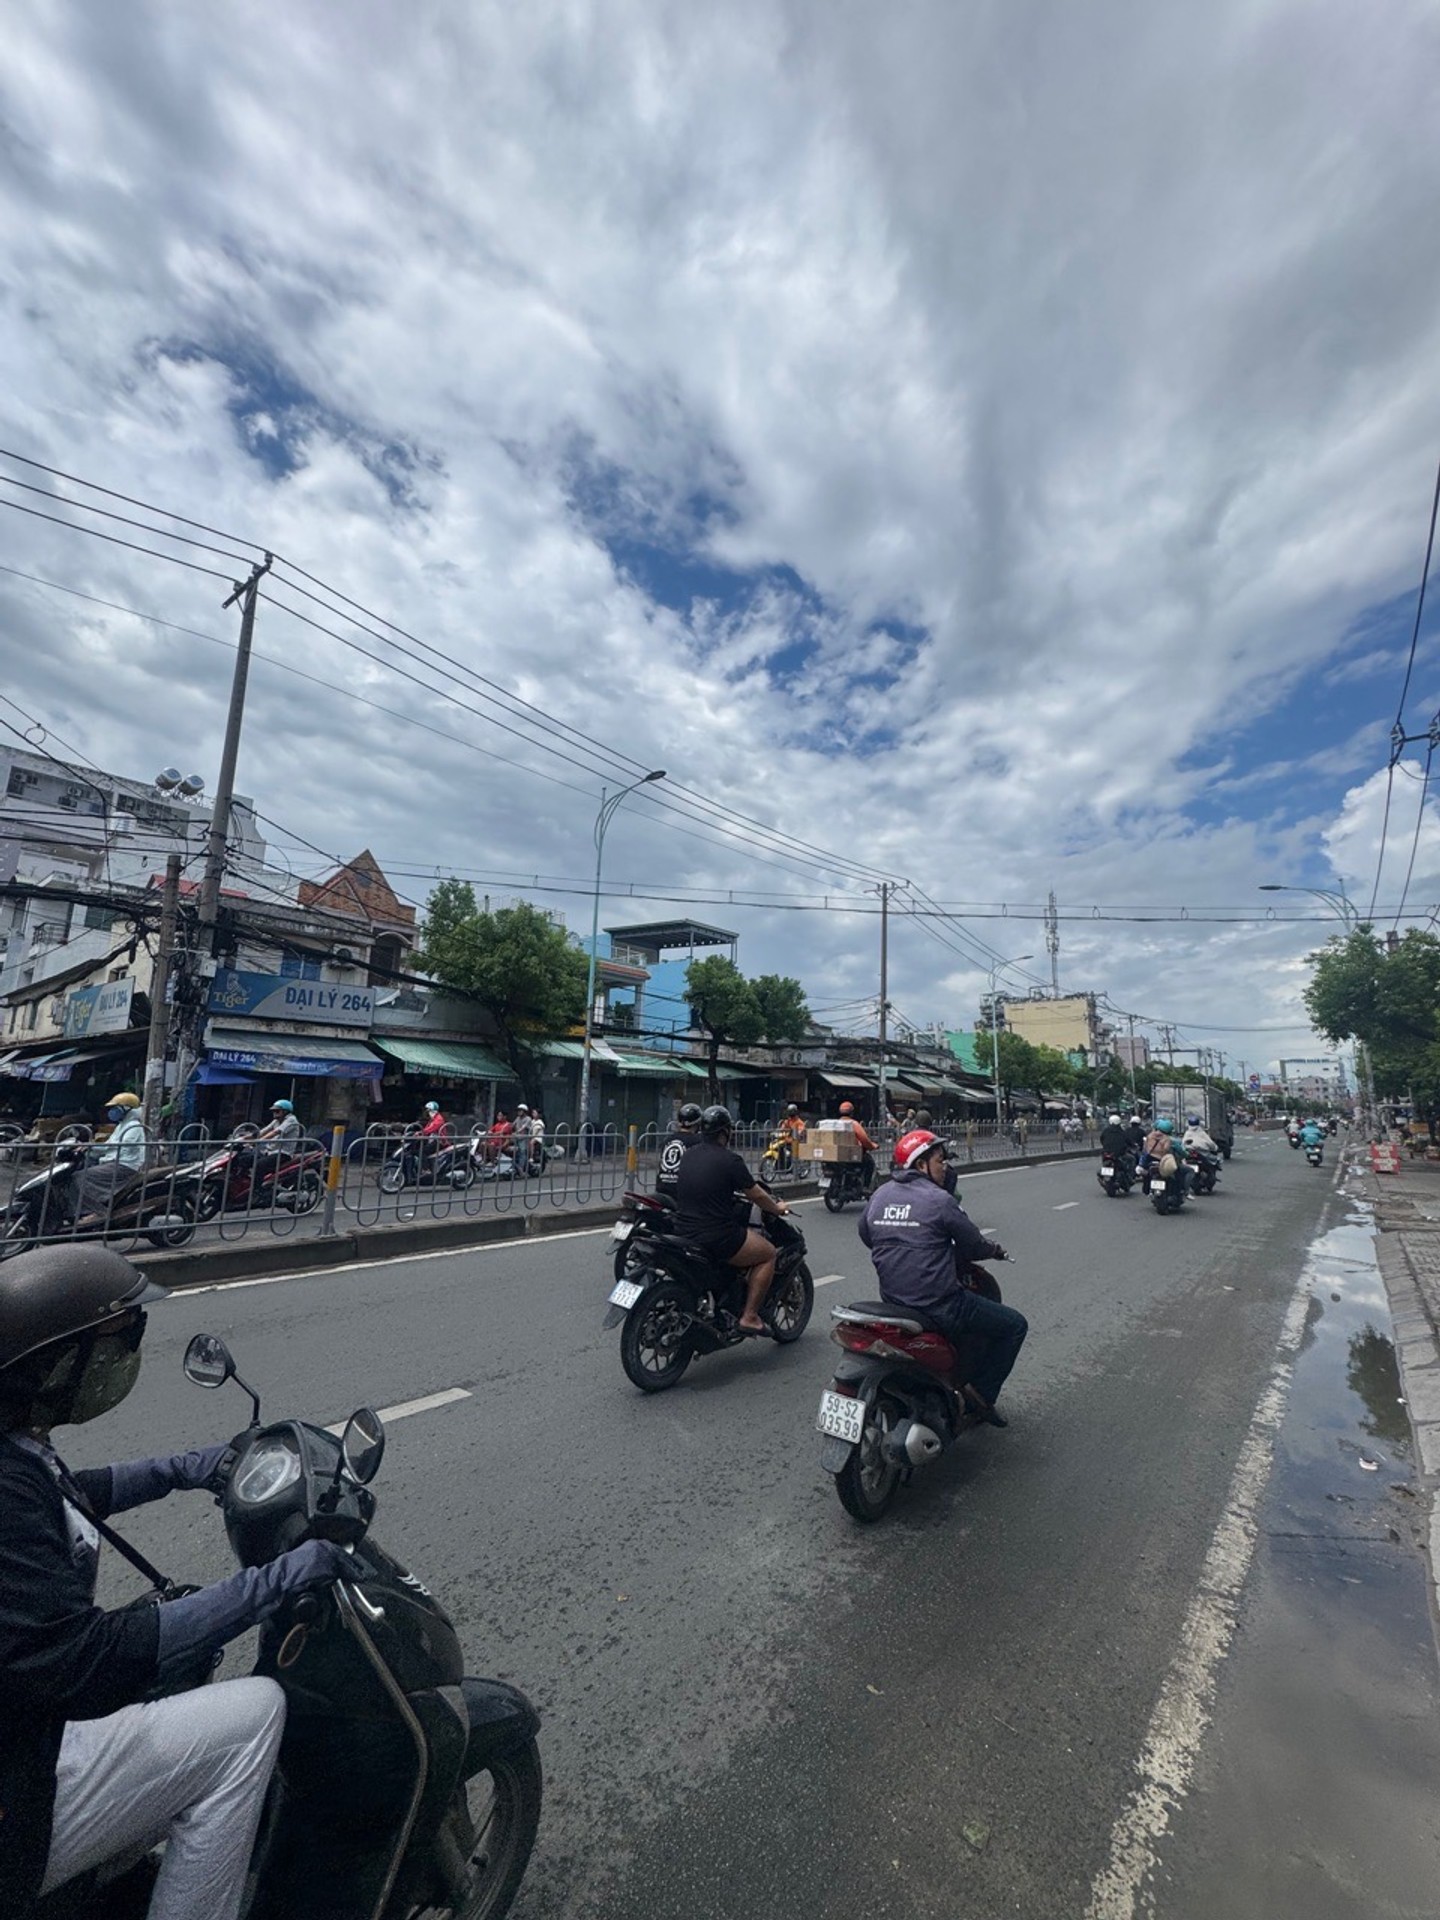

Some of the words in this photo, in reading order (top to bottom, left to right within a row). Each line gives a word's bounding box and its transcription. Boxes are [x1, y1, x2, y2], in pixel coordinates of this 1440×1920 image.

[213, 991, 250, 1008] Tiger
[285, 987, 313, 1010] ĐẠI
[318, 988, 338, 1009] LÝ
[341, 994, 371, 1012] 264
[827, 1395, 859, 1420] 59-S2
